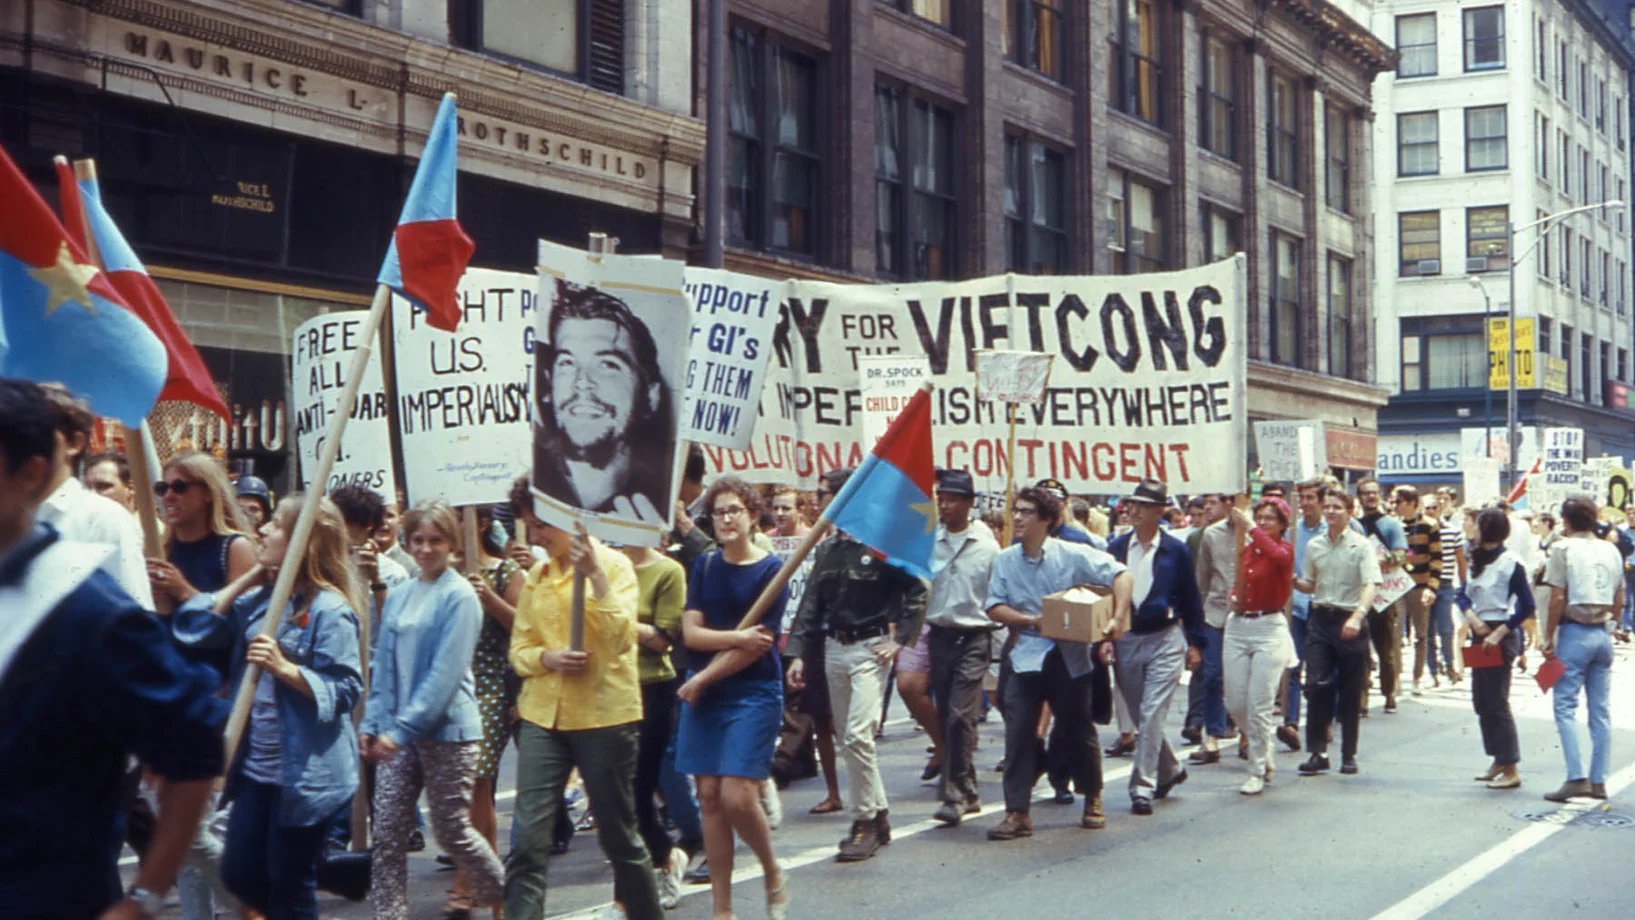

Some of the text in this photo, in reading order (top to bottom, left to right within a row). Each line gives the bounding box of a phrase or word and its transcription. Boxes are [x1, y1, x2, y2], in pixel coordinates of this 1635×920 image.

[125, 31, 308, 97] MAURICE
[457, 115, 646, 179] ROTHSCHILD
[297, 320, 360, 366] FREE
[707, 322, 759, 360] GI's
[841, 314, 898, 340] FOR
[907, 284, 1227, 376] VIETCONG
[430, 336, 487, 375] U.S.
[309, 361, 346, 396] ALL
[703, 361, 753, 400] THEM
[691, 399, 741, 437] NOW!
[866, 396, 898, 412] CHILD
[946, 438, 1190, 484] CONTINGENT
